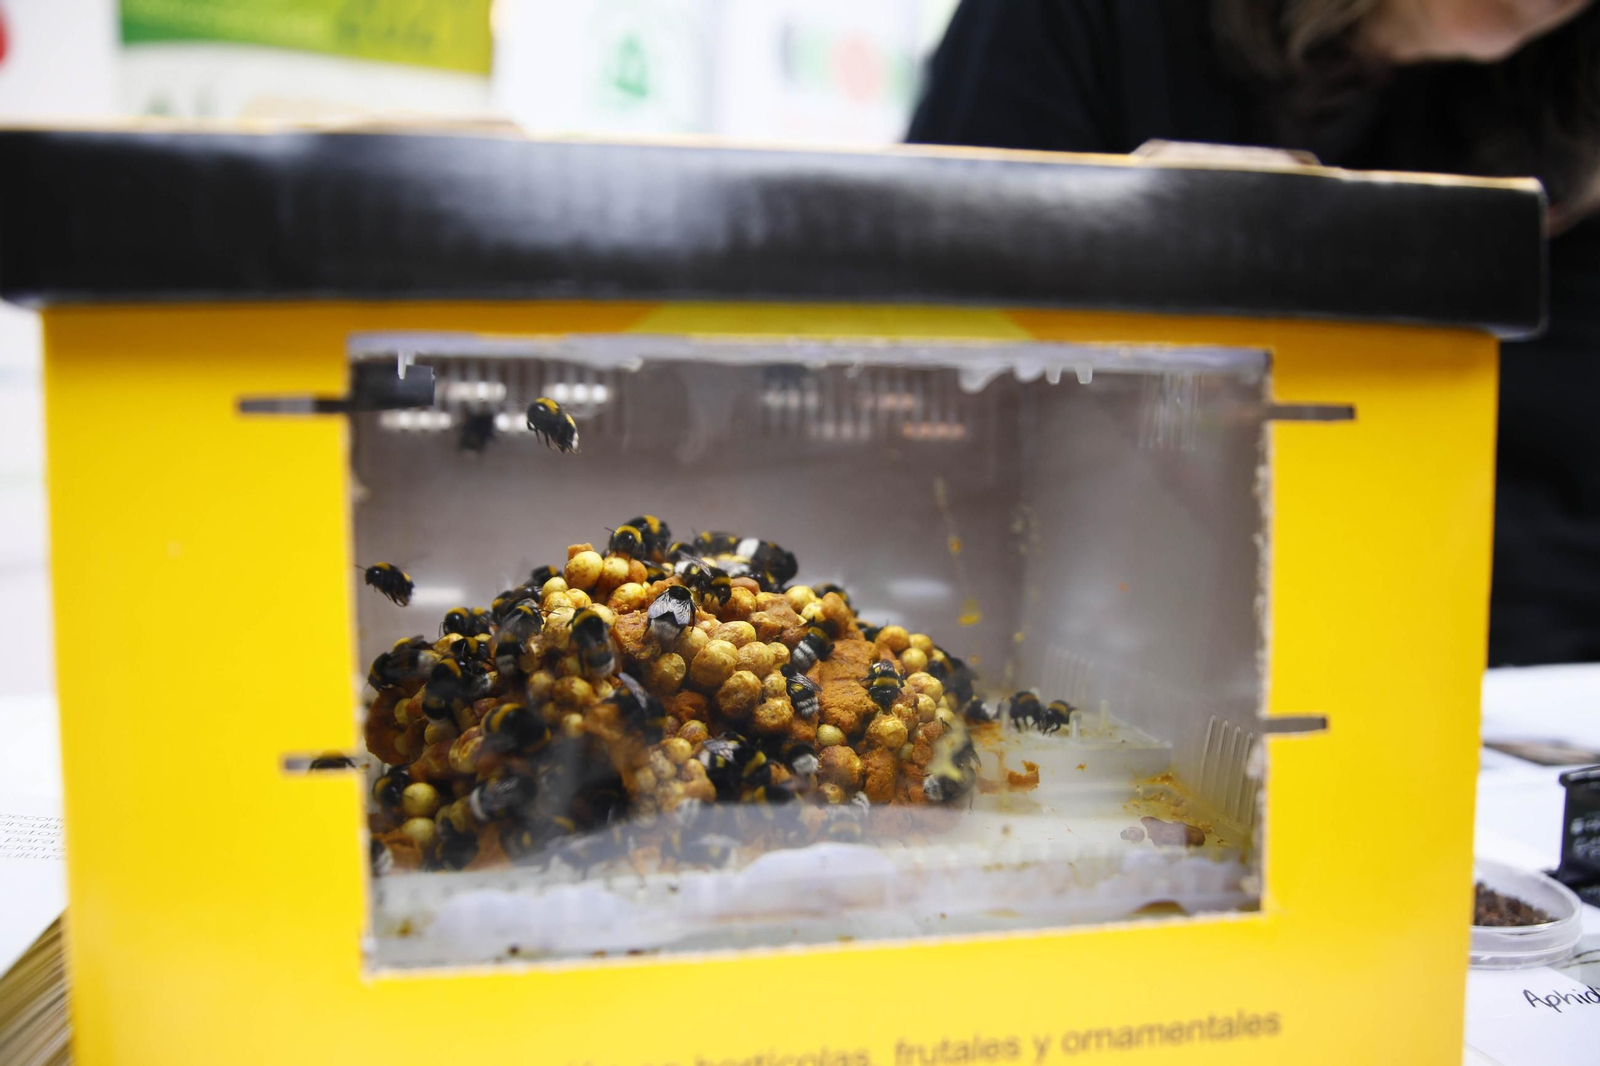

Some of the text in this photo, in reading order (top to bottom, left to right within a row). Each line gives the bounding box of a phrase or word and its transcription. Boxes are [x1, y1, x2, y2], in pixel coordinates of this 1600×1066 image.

[5, 837, 55, 845] para
[1522, 984, 1600, 1013] Aphid
[895, 1031, 1021, 1066] frutales
[1032, 1032, 1052, 1066] y
[1062, 1009, 1281, 1056] ornamentales
